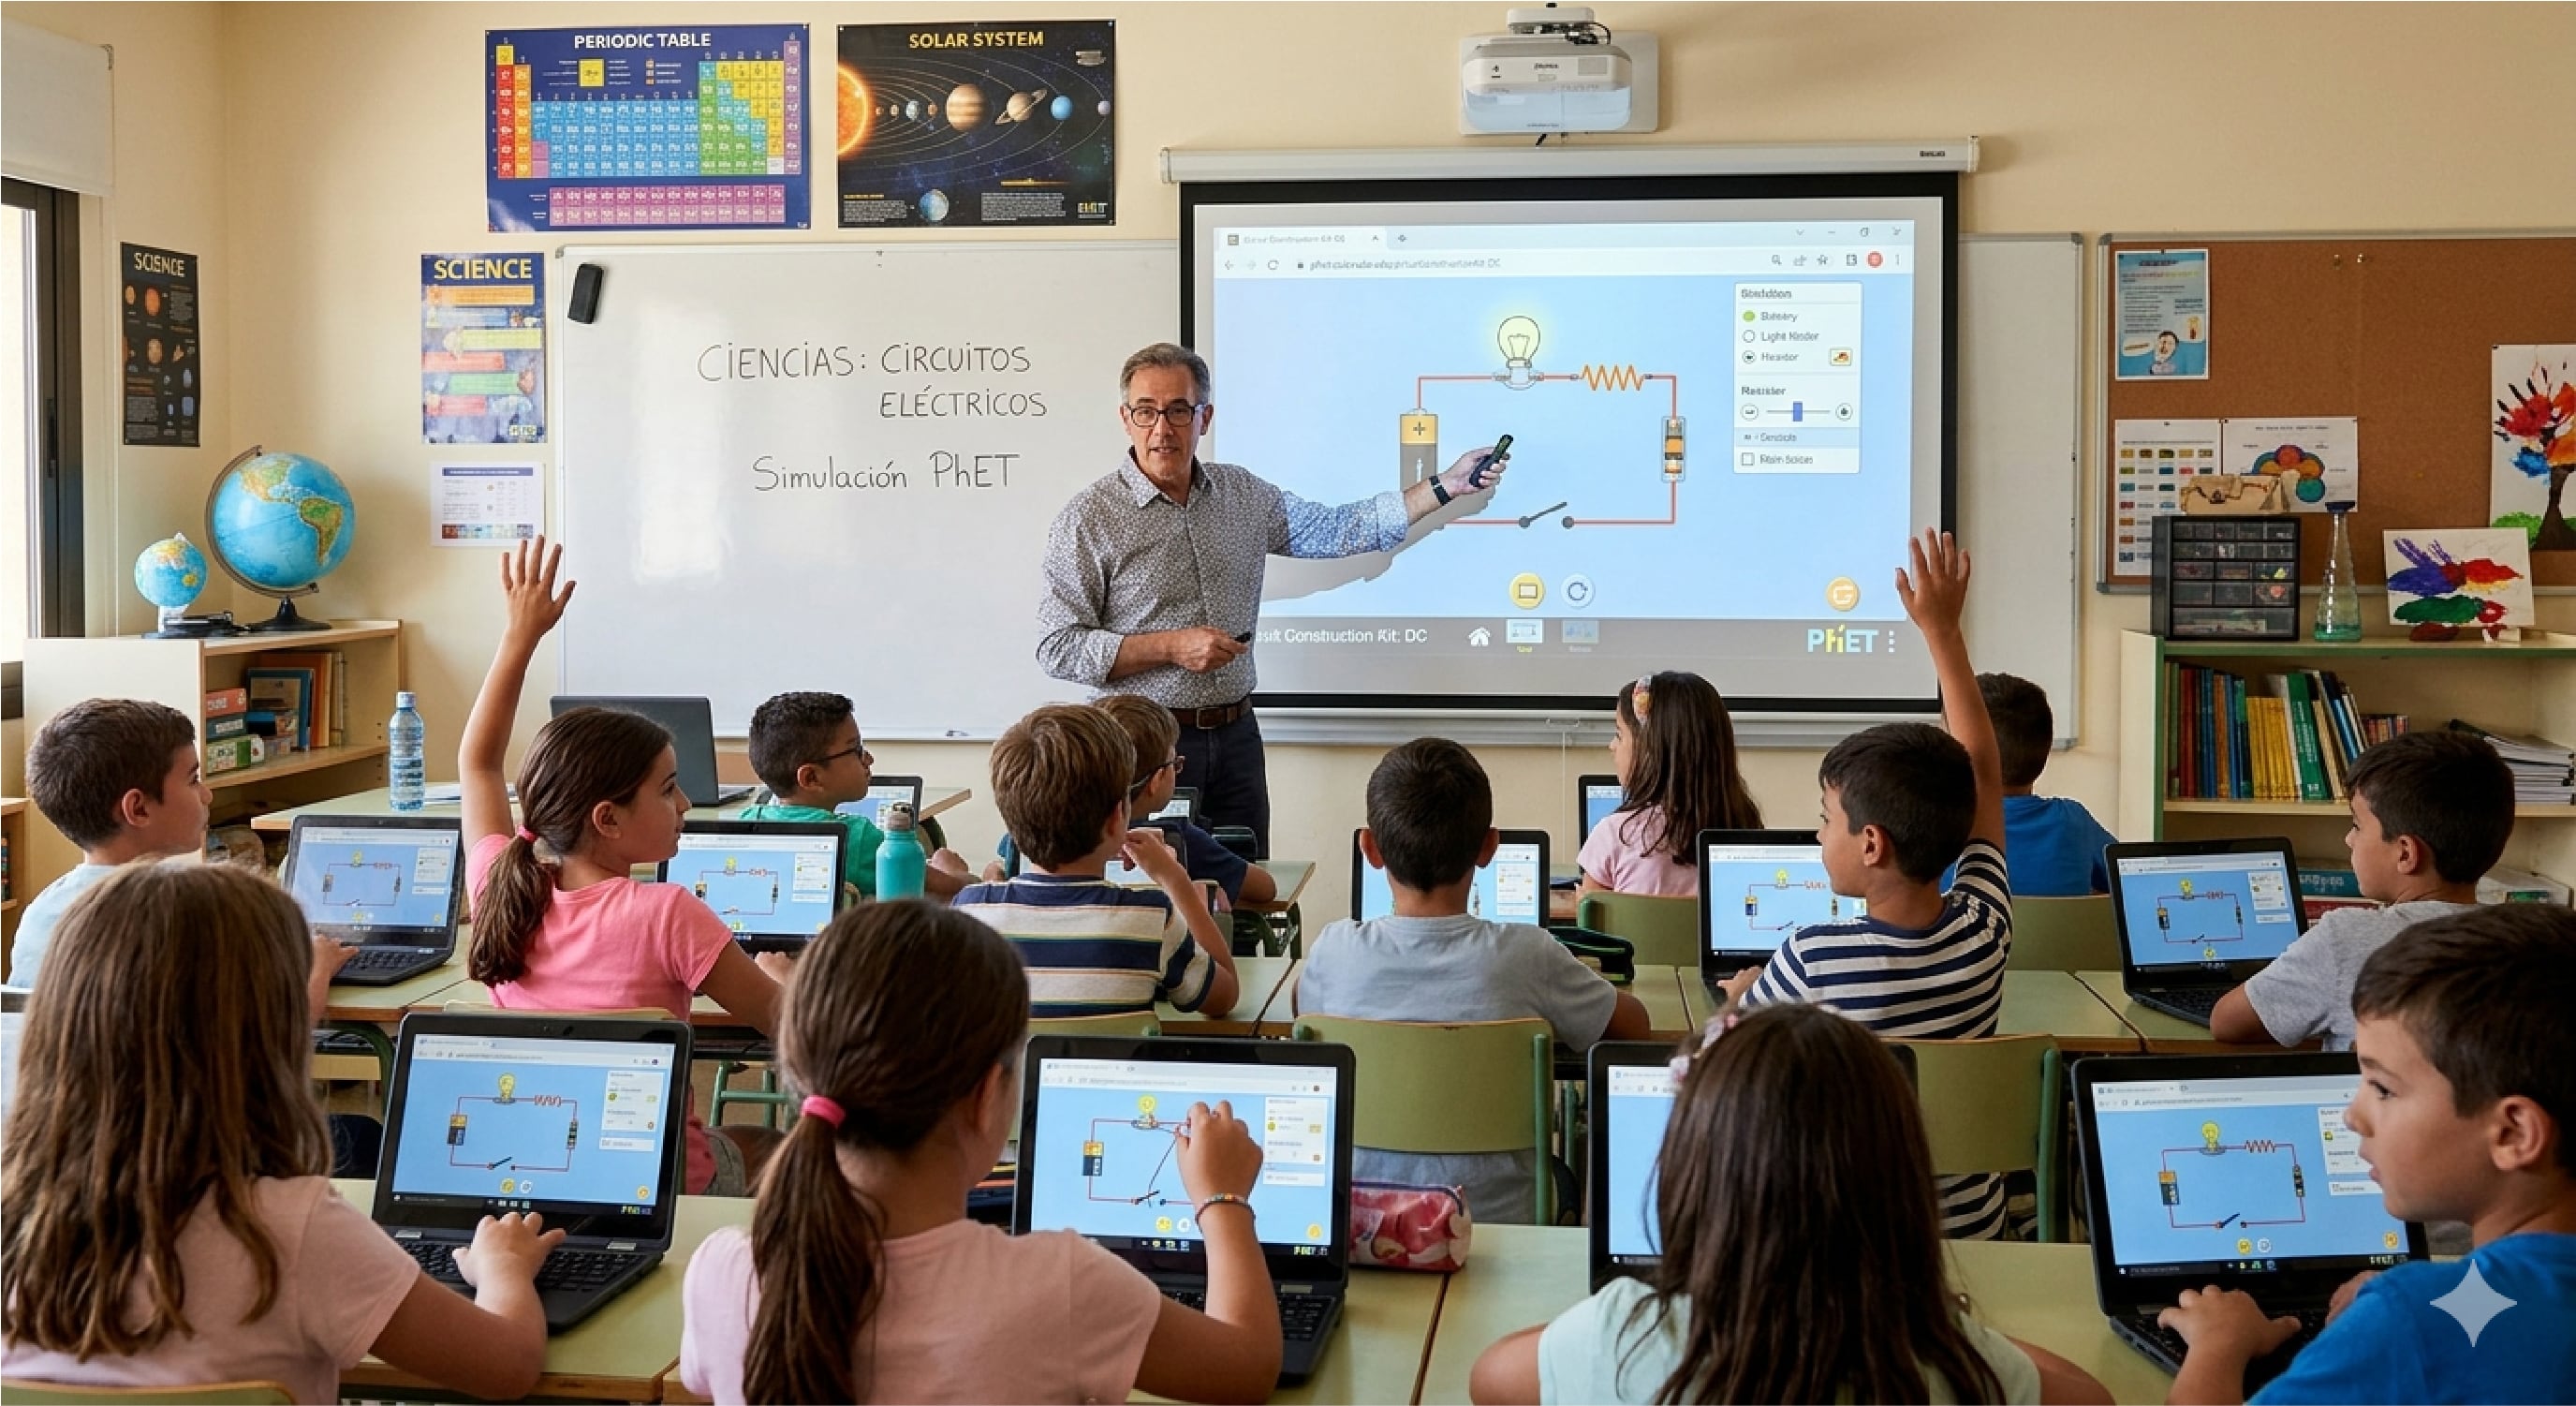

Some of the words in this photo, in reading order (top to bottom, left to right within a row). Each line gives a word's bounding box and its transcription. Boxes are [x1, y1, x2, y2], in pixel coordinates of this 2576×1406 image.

[574, 35, 655, 48] PERIODIC
[656, 33, 712, 47] TABLE
[909, 33, 968, 48] SOLAR
[973, 31, 1044, 47] SYSTEM
[134, 252, 185, 277] SCIENCE
[434, 258, 533, 280] SCIENCE
[752, 456, 907, 491] Simulación
[929, 451, 1021, 488] PhET
[1405, 629, 1428, 644] DC
